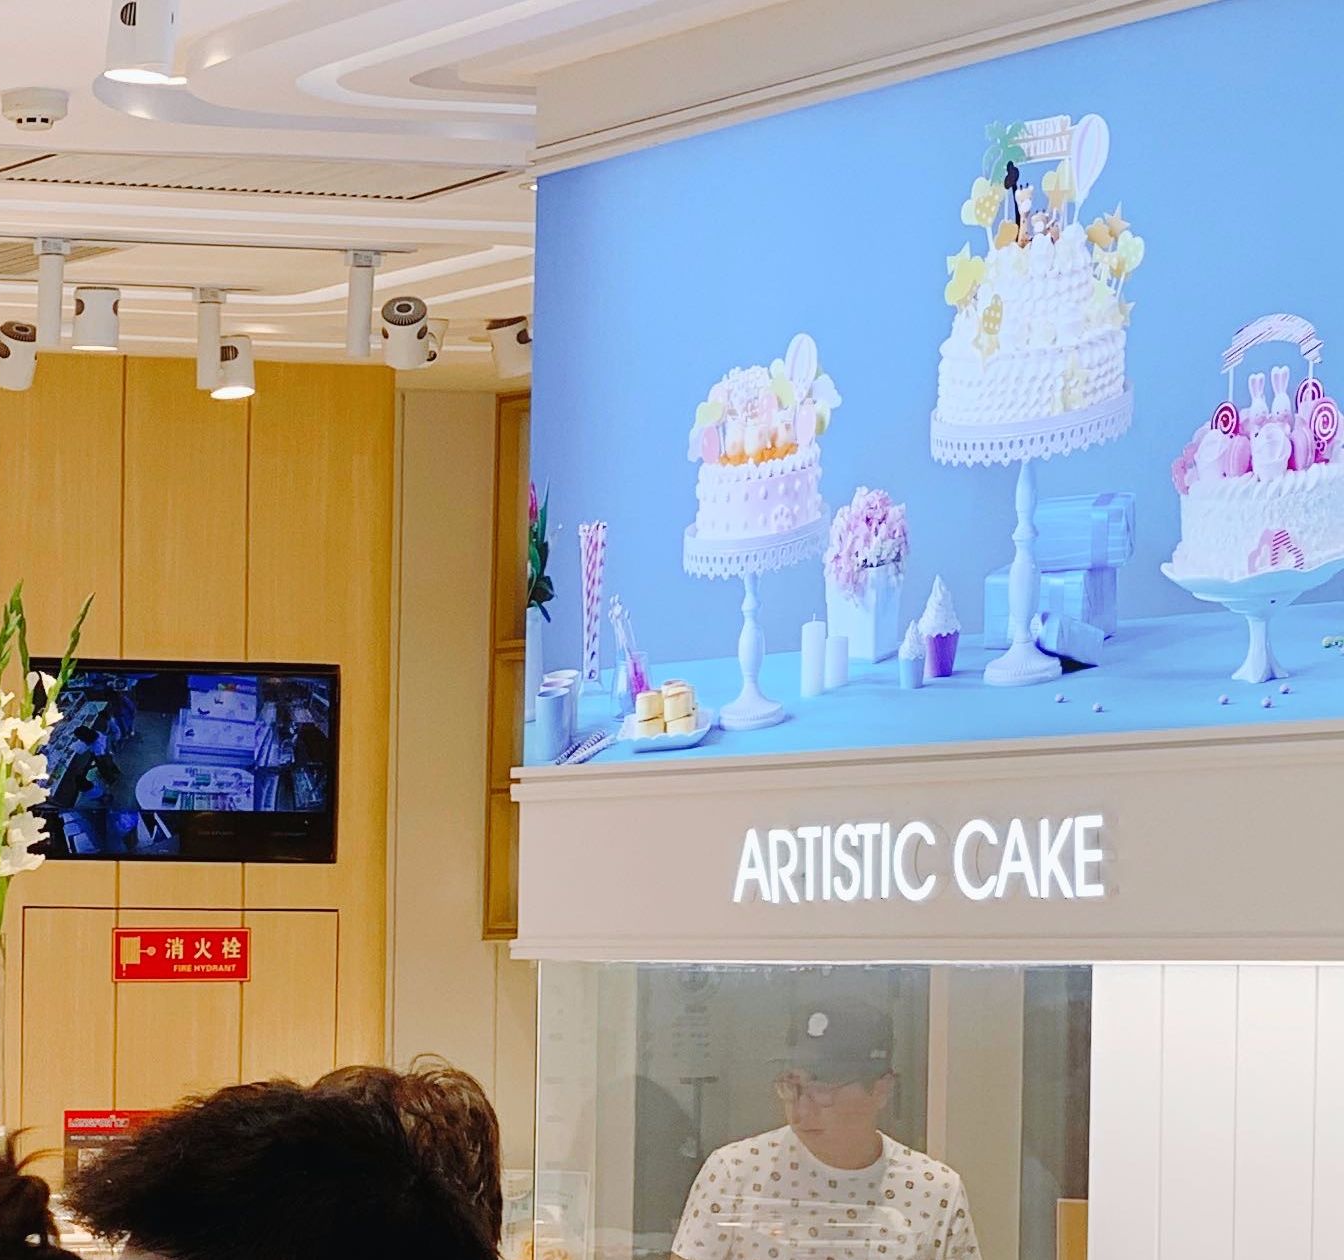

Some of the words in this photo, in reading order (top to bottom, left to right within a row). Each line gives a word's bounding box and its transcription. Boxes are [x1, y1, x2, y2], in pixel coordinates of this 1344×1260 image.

[733, 821, 937, 904] ARTISTIC
[953, 814, 1105, 901] CAKE
[165, 936, 242, 960] 消火栓
[173, 964, 192, 973] FIRE
[193, 963, 237, 973] HYDRANT
